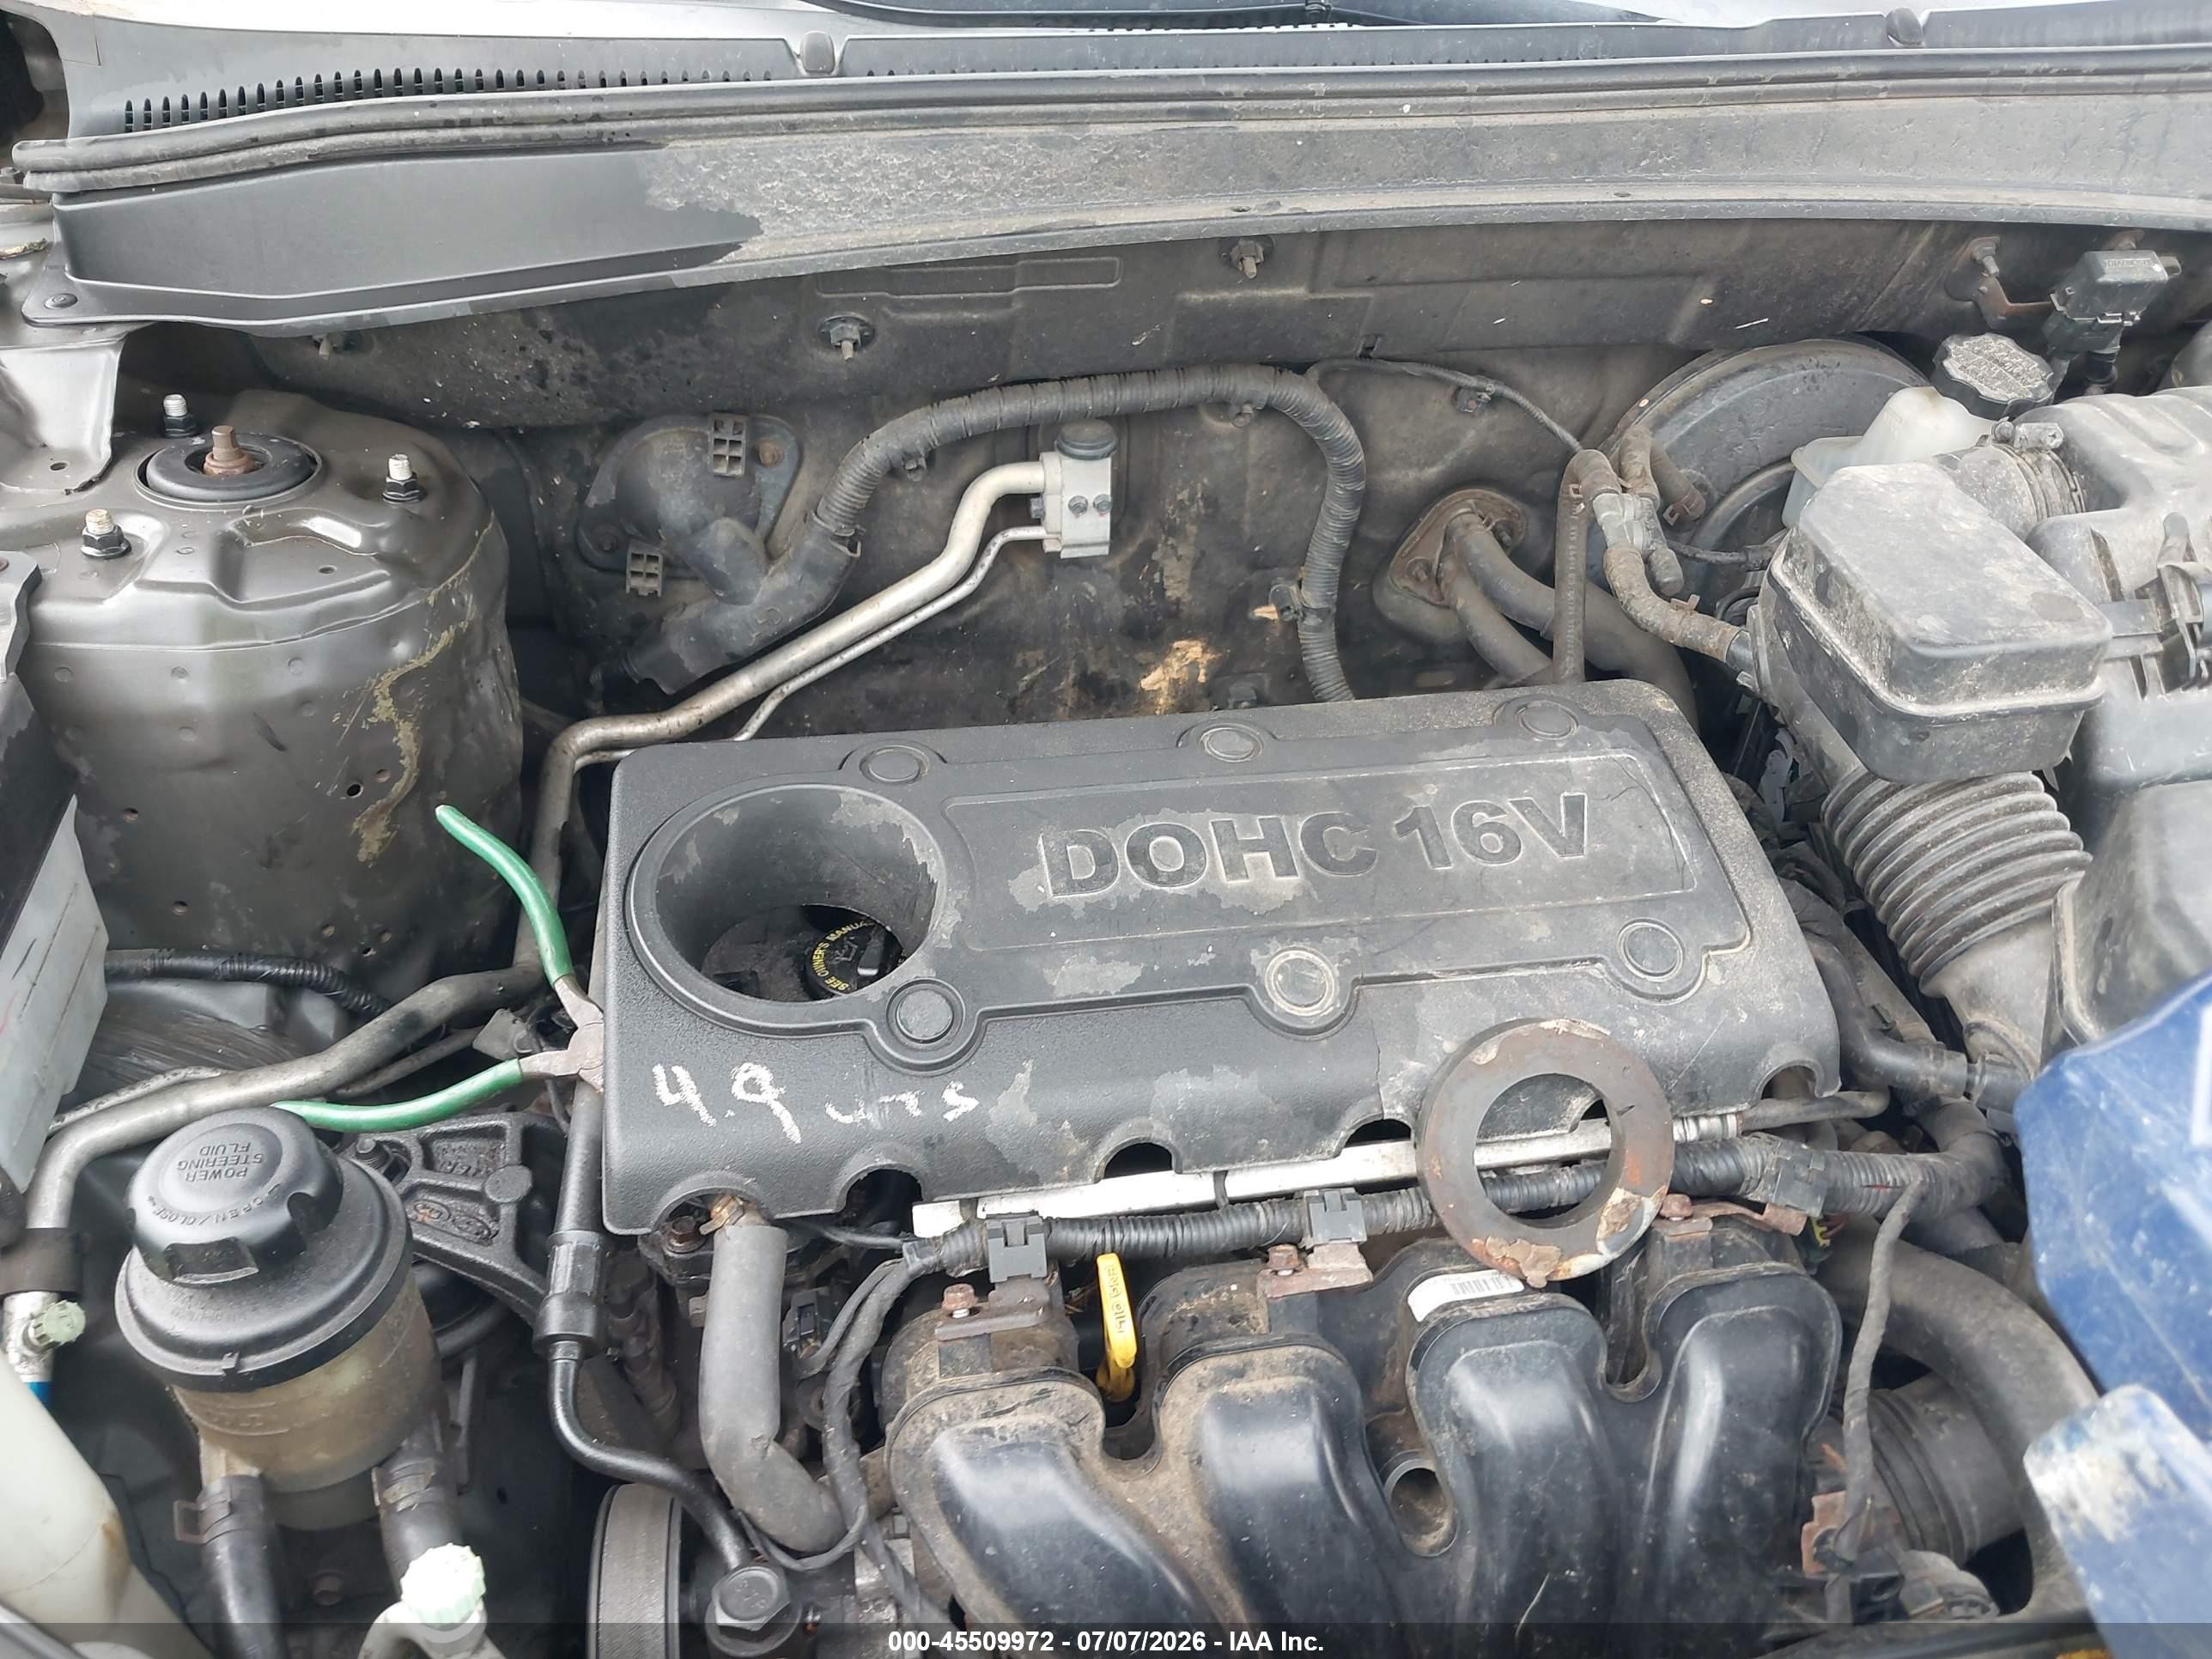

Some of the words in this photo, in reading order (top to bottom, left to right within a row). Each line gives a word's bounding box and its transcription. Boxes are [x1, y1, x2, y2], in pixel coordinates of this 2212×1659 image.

[1040, 811, 1377, 898] DOHC
[1393, 793, 1587, 871] 16V
[812, 942, 830, 977] OWNER'S
[825, 977, 848, 990] SEE
[652, 1062, 802, 1144] 4.9
[199, 1142, 251, 1155] FLUID
[178, 1153, 263, 1170] STEERING
[185, 1166, 248, 1182] POWER
